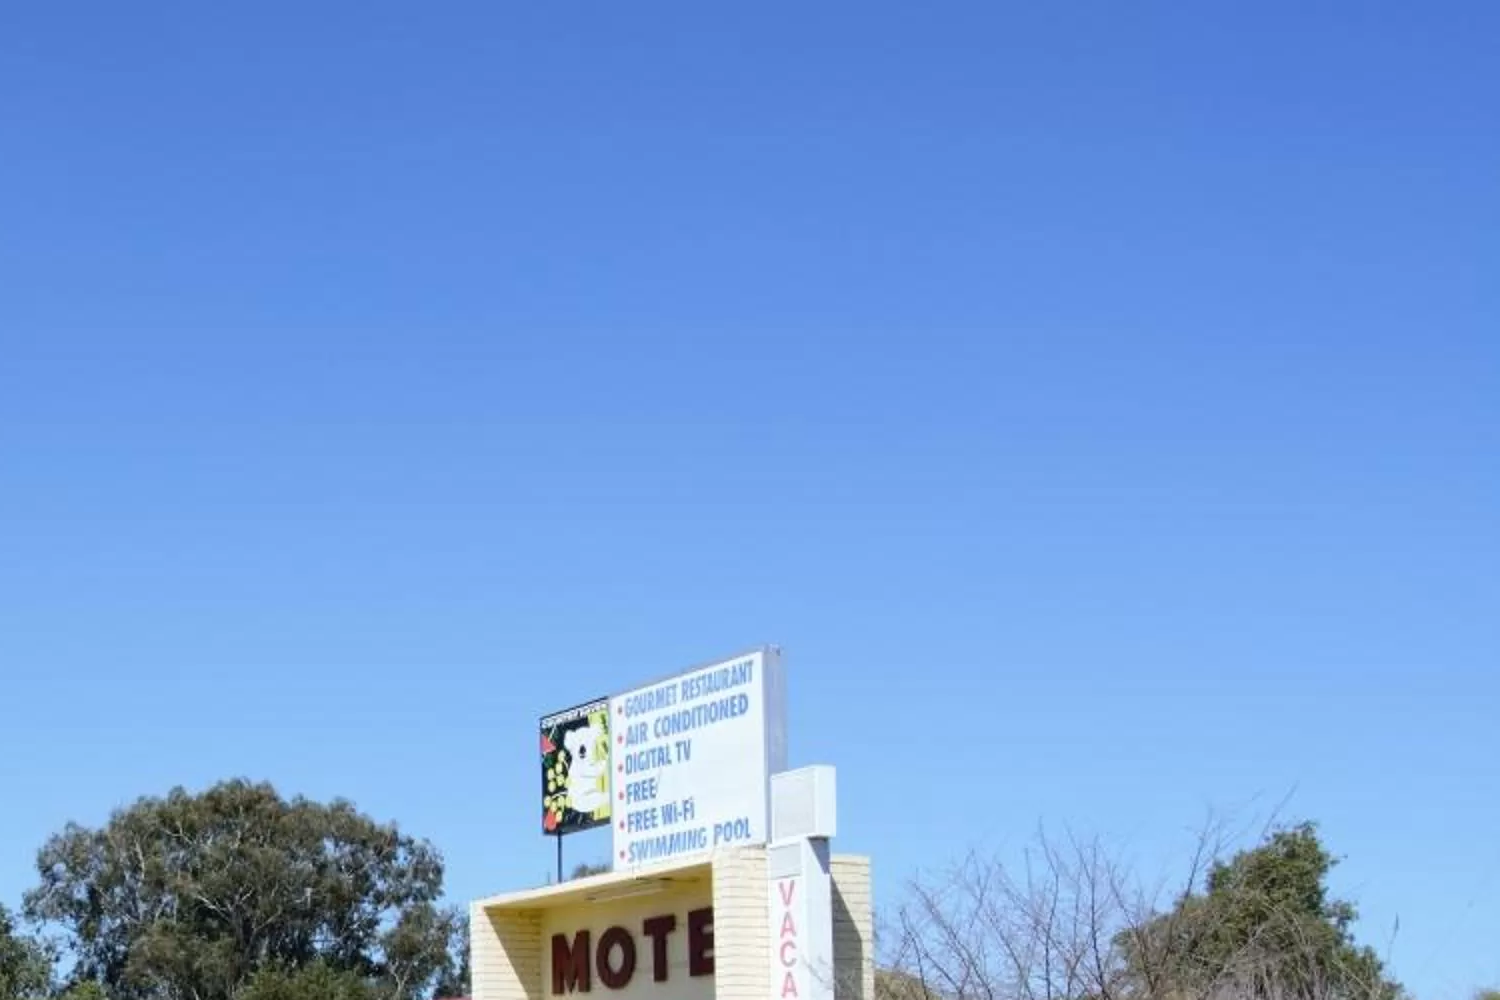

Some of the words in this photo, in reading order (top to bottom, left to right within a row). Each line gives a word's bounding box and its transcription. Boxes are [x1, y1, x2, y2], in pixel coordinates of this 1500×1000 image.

[625, 684, 677, 718] GOURMET
[680, 660, 754, 701] RESTAURANT
[625, 722, 648, 747] AIR
[654, 693, 749, 738] CONDITIONED
[625, 744, 672, 775] DIGITAL
[676, 739, 692, 762] TV
[626, 778, 657, 804] FREE
[627, 807, 659, 833] FREE
[628, 827, 707, 862] SWIMMING
[713, 816, 751, 846] POOL
[551, 906, 714, 996] MOTE
